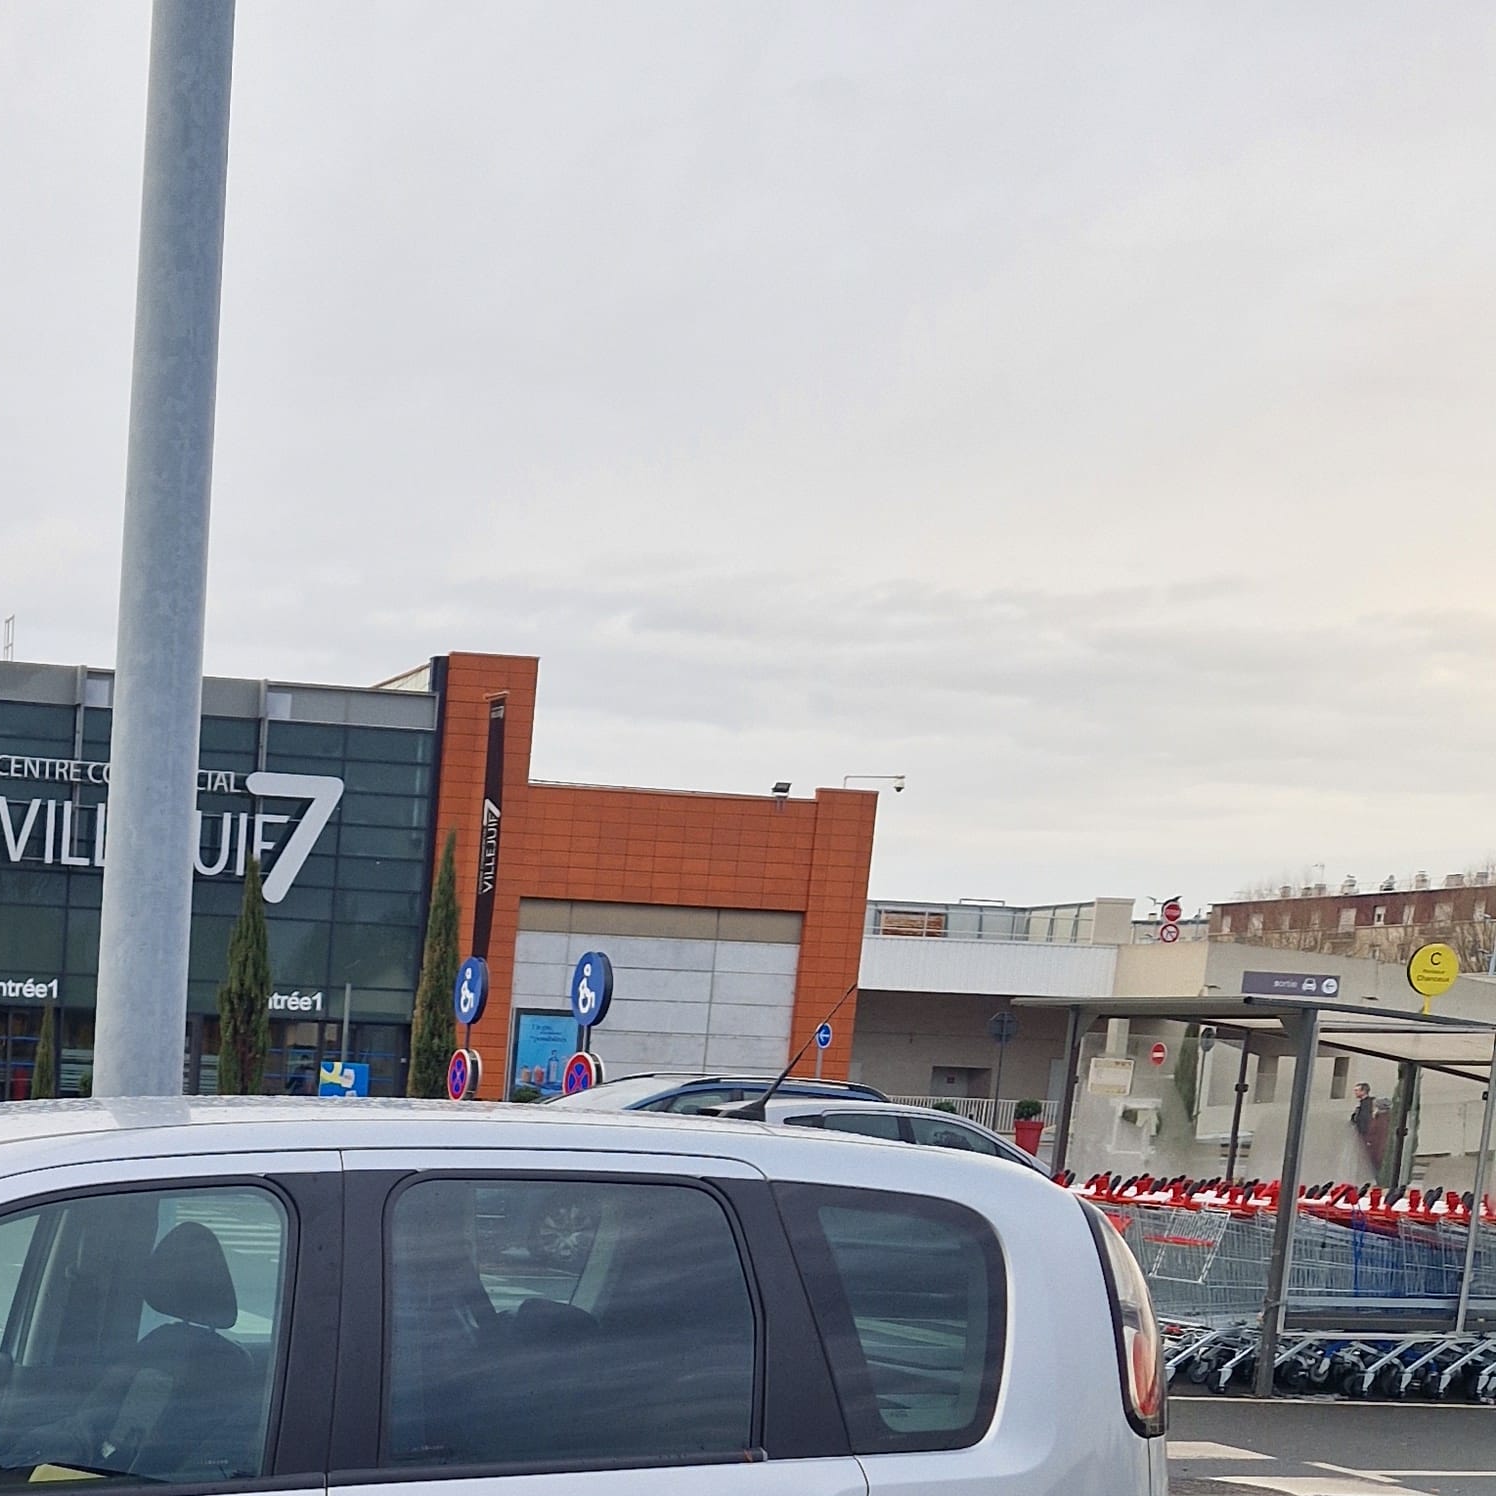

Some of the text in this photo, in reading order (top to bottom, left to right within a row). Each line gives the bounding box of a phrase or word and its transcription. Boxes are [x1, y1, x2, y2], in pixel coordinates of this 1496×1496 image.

[482, 812, 500, 894] VILLEJUIF
[1430, 952, 1442, 966] C
[268, 991, 322, 1011] trée1
